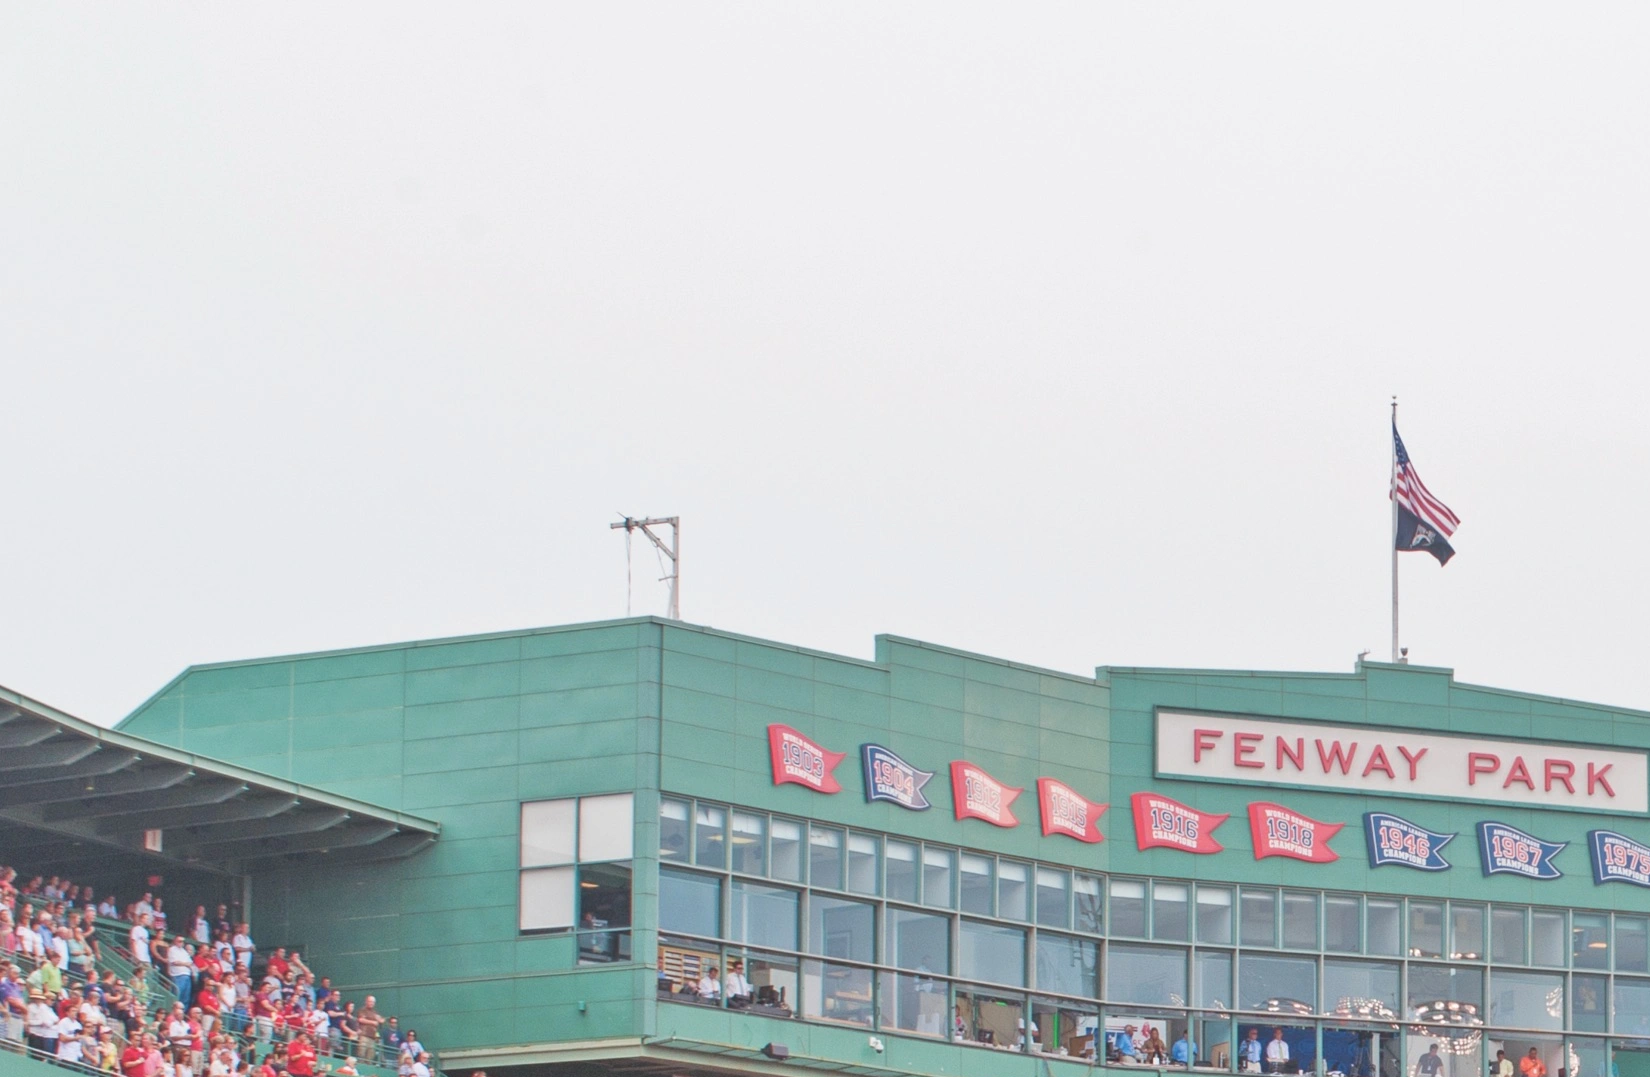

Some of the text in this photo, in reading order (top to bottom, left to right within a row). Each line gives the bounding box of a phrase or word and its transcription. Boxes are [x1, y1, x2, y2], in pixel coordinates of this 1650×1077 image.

[782, 741, 825, 779] 1903
[1193, 728, 1616, 797] FENWAY PARK
[874, 759, 914, 796] 1904
[965, 777, 1001, 812] 1912
[1051, 793, 1087, 828] 1915
[1149, 800, 1200, 821] WORLD SERIES
[1265, 809, 1315, 831] WORLD SERIES
[1150, 807, 1199, 839] 1916
[1266, 817, 1314, 848] 1918
[1380, 819, 1429, 840] AMERICAN LEAGUE
[1152, 830, 1198, 849] CHAMPIONS
[1269, 839, 1313, 858] CHAMPIONS
[1379, 826, 1430, 858] 1946
[1493, 828, 1541, 848] AMERICAN LEAGUE
[1604, 837, 1631, 849] AMERICAN
[1383, 848, 1427, 867] CHAMPIONS
[1492, 835, 1543, 867] 1967
[1496, 857, 1540, 876] CHAMPIONS
[1607, 865, 1650, 883] CHAMPIONS
